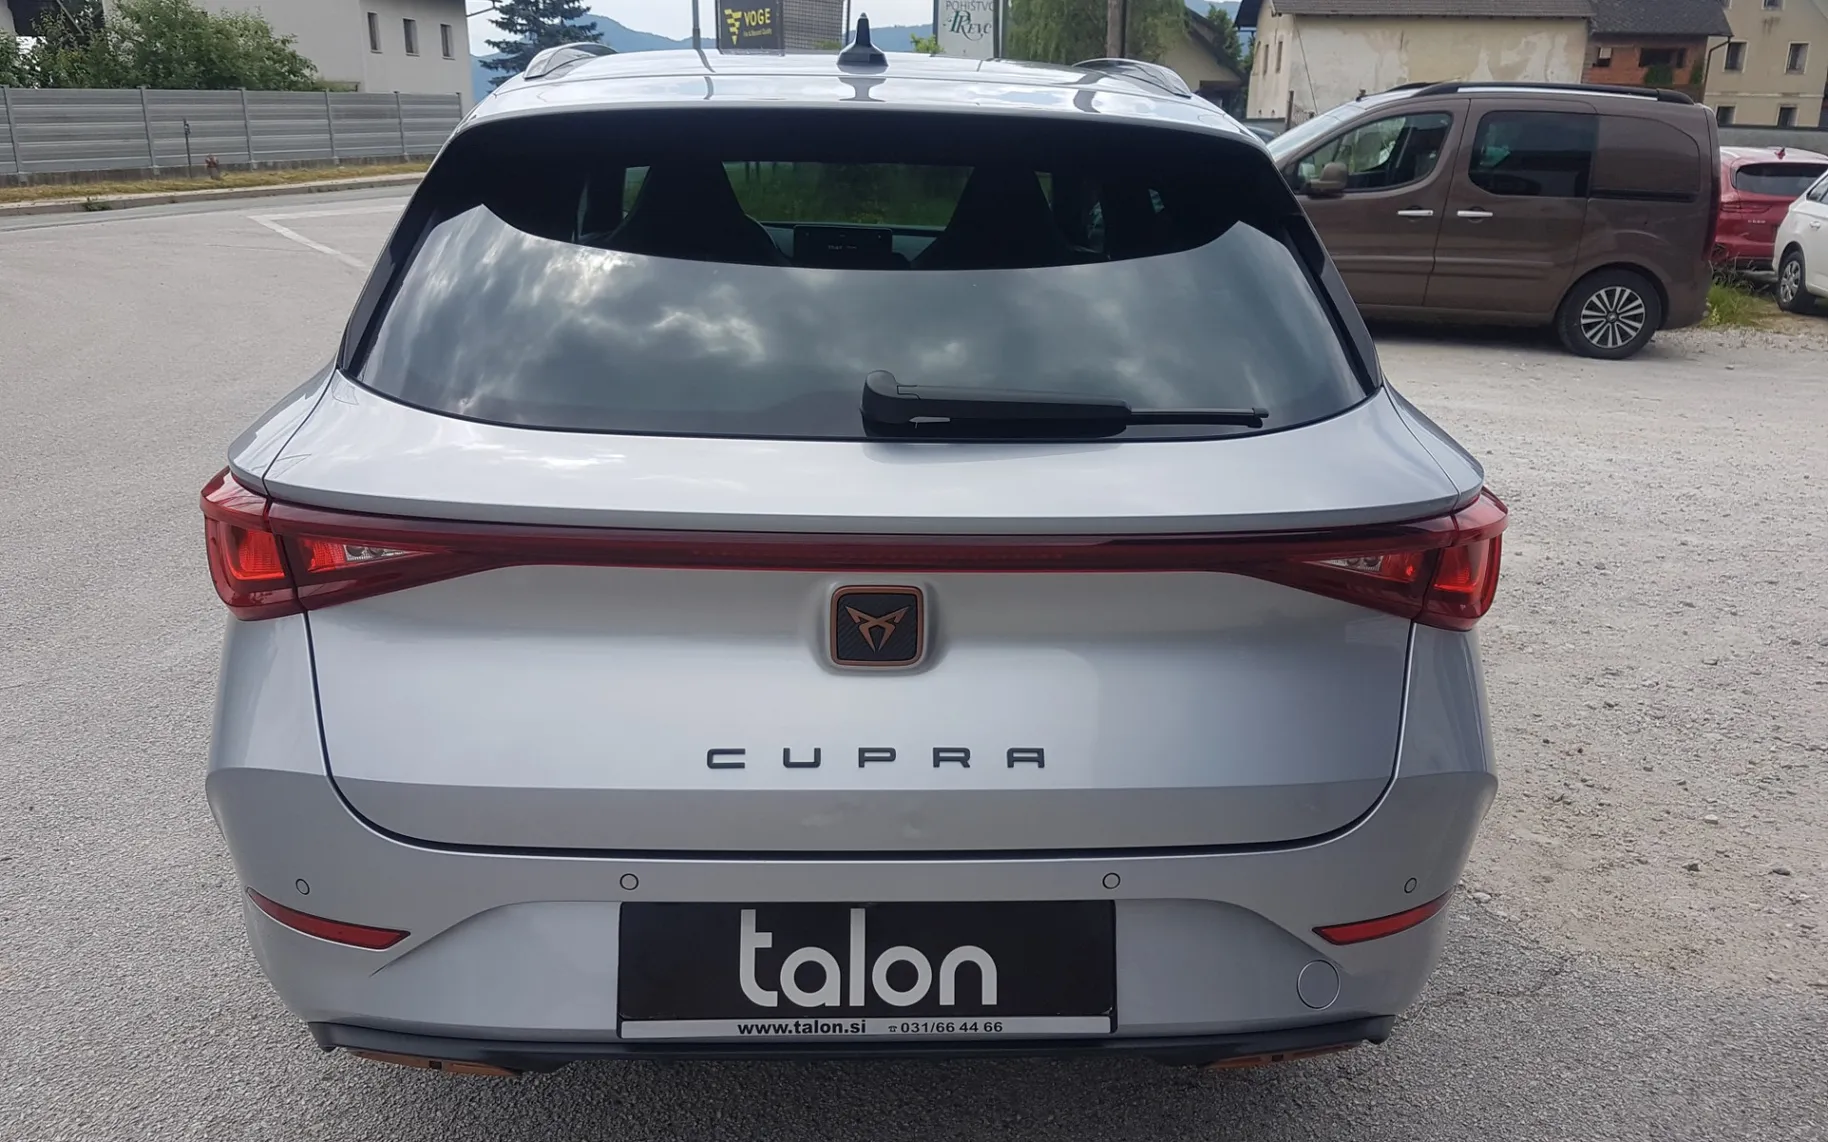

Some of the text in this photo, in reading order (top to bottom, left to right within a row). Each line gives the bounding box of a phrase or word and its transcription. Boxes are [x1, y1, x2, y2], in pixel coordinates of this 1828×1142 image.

[744, 8, 771, 27] VOGE
[706, 747, 1046, 769] CUPRA
[739, 908, 999, 1008] talon
[737, 1019, 866, 1035] www.talon.si
[901, 1021, 1004, 1033] 031/66 44 66
